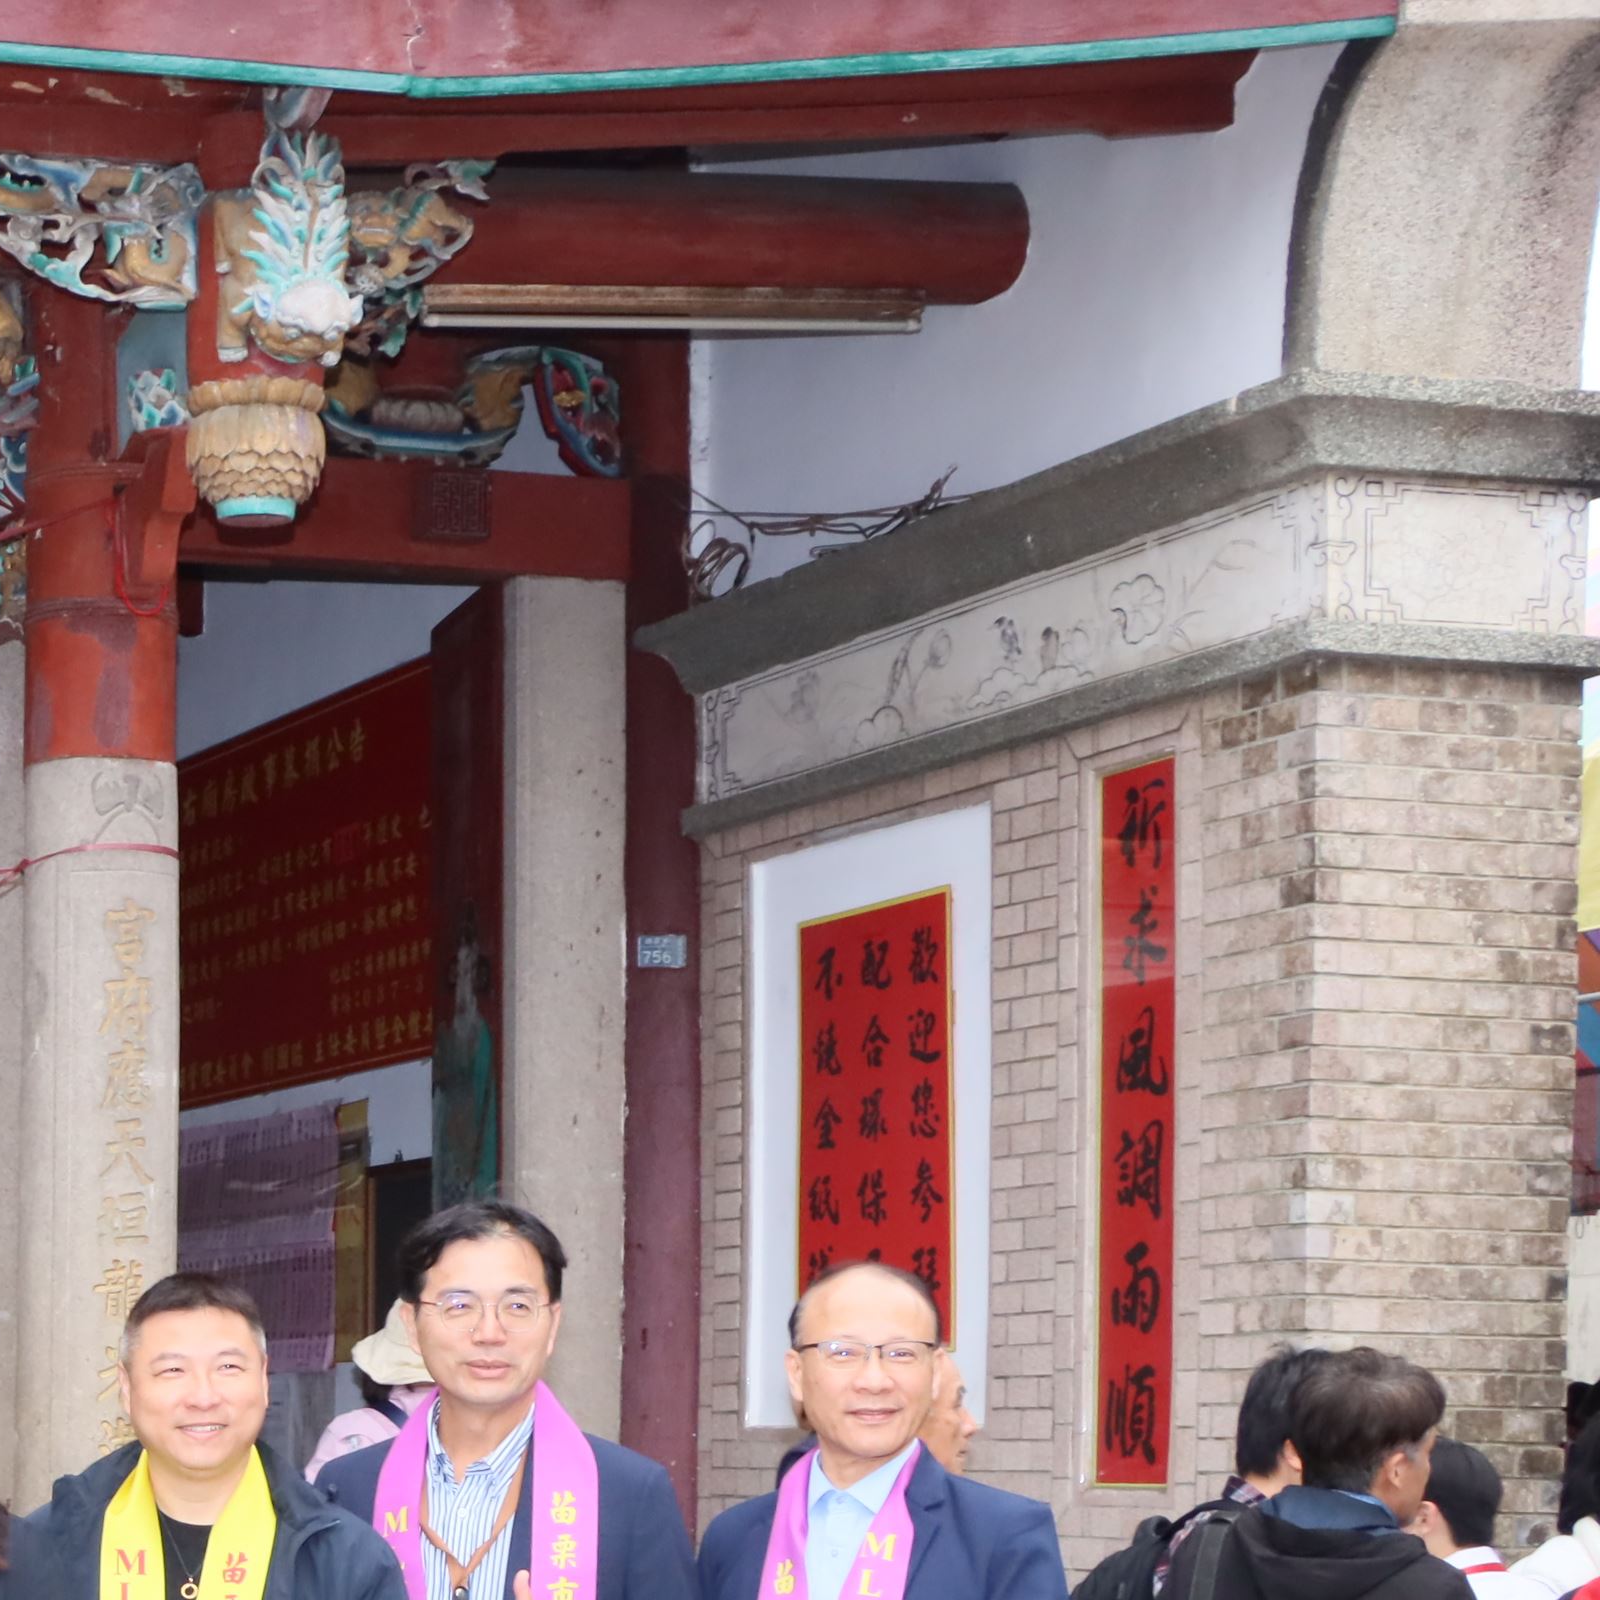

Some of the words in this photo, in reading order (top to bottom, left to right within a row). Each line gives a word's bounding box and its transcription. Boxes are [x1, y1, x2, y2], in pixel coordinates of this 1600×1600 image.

[642, 950, 672, 964] 756
[858, 938, 893, 1262] 配合環保
[1103, 778, 1169, 1466] 祈求風調雨順
